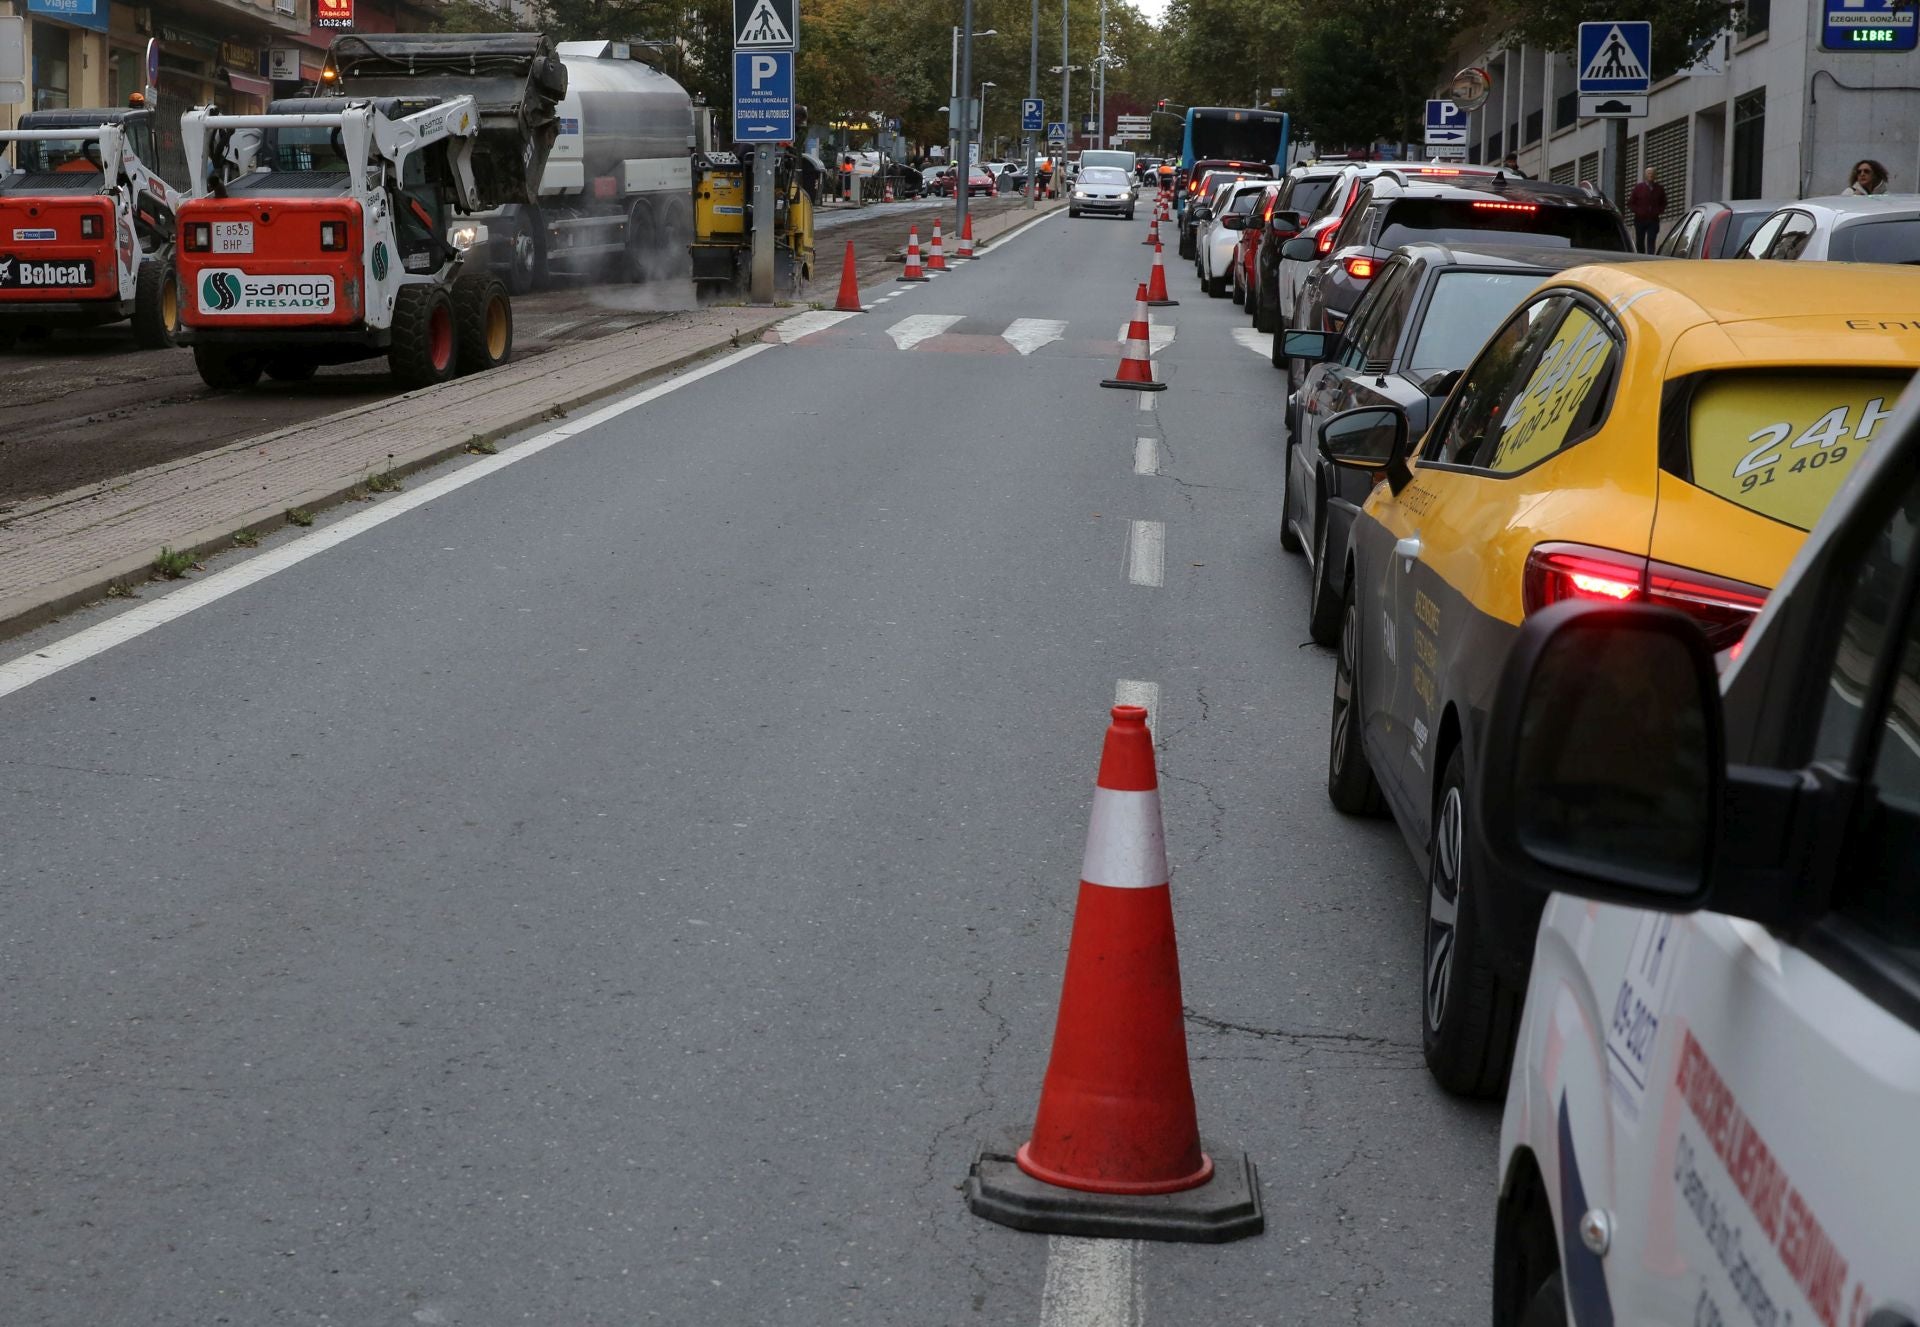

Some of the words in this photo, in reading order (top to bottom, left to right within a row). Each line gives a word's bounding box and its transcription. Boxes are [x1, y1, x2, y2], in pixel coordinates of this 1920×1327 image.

[319, 18, 352, 27] 10:32:48
[1830, 15, 1867, 23] EZEQUIEL
[1853, 29, 1893, 41] LIBRE
[751, 55, 777, 89] P
[758, 110, 765, 119] DE
[765, 109, 790, 119] AUTOBUSES
[1024, 101, 1037, 117] P
[1440, 102, 1459, 125] P
[216, 226, 221, 236] E
[226, 224, 250, 236] 8525
[223, 239, 242, 250] BHP
[19, 263, 87, 285] Bobcat
[1740, 467, 1776, 494] 91
[1788, 446, 1848, 474] 409
